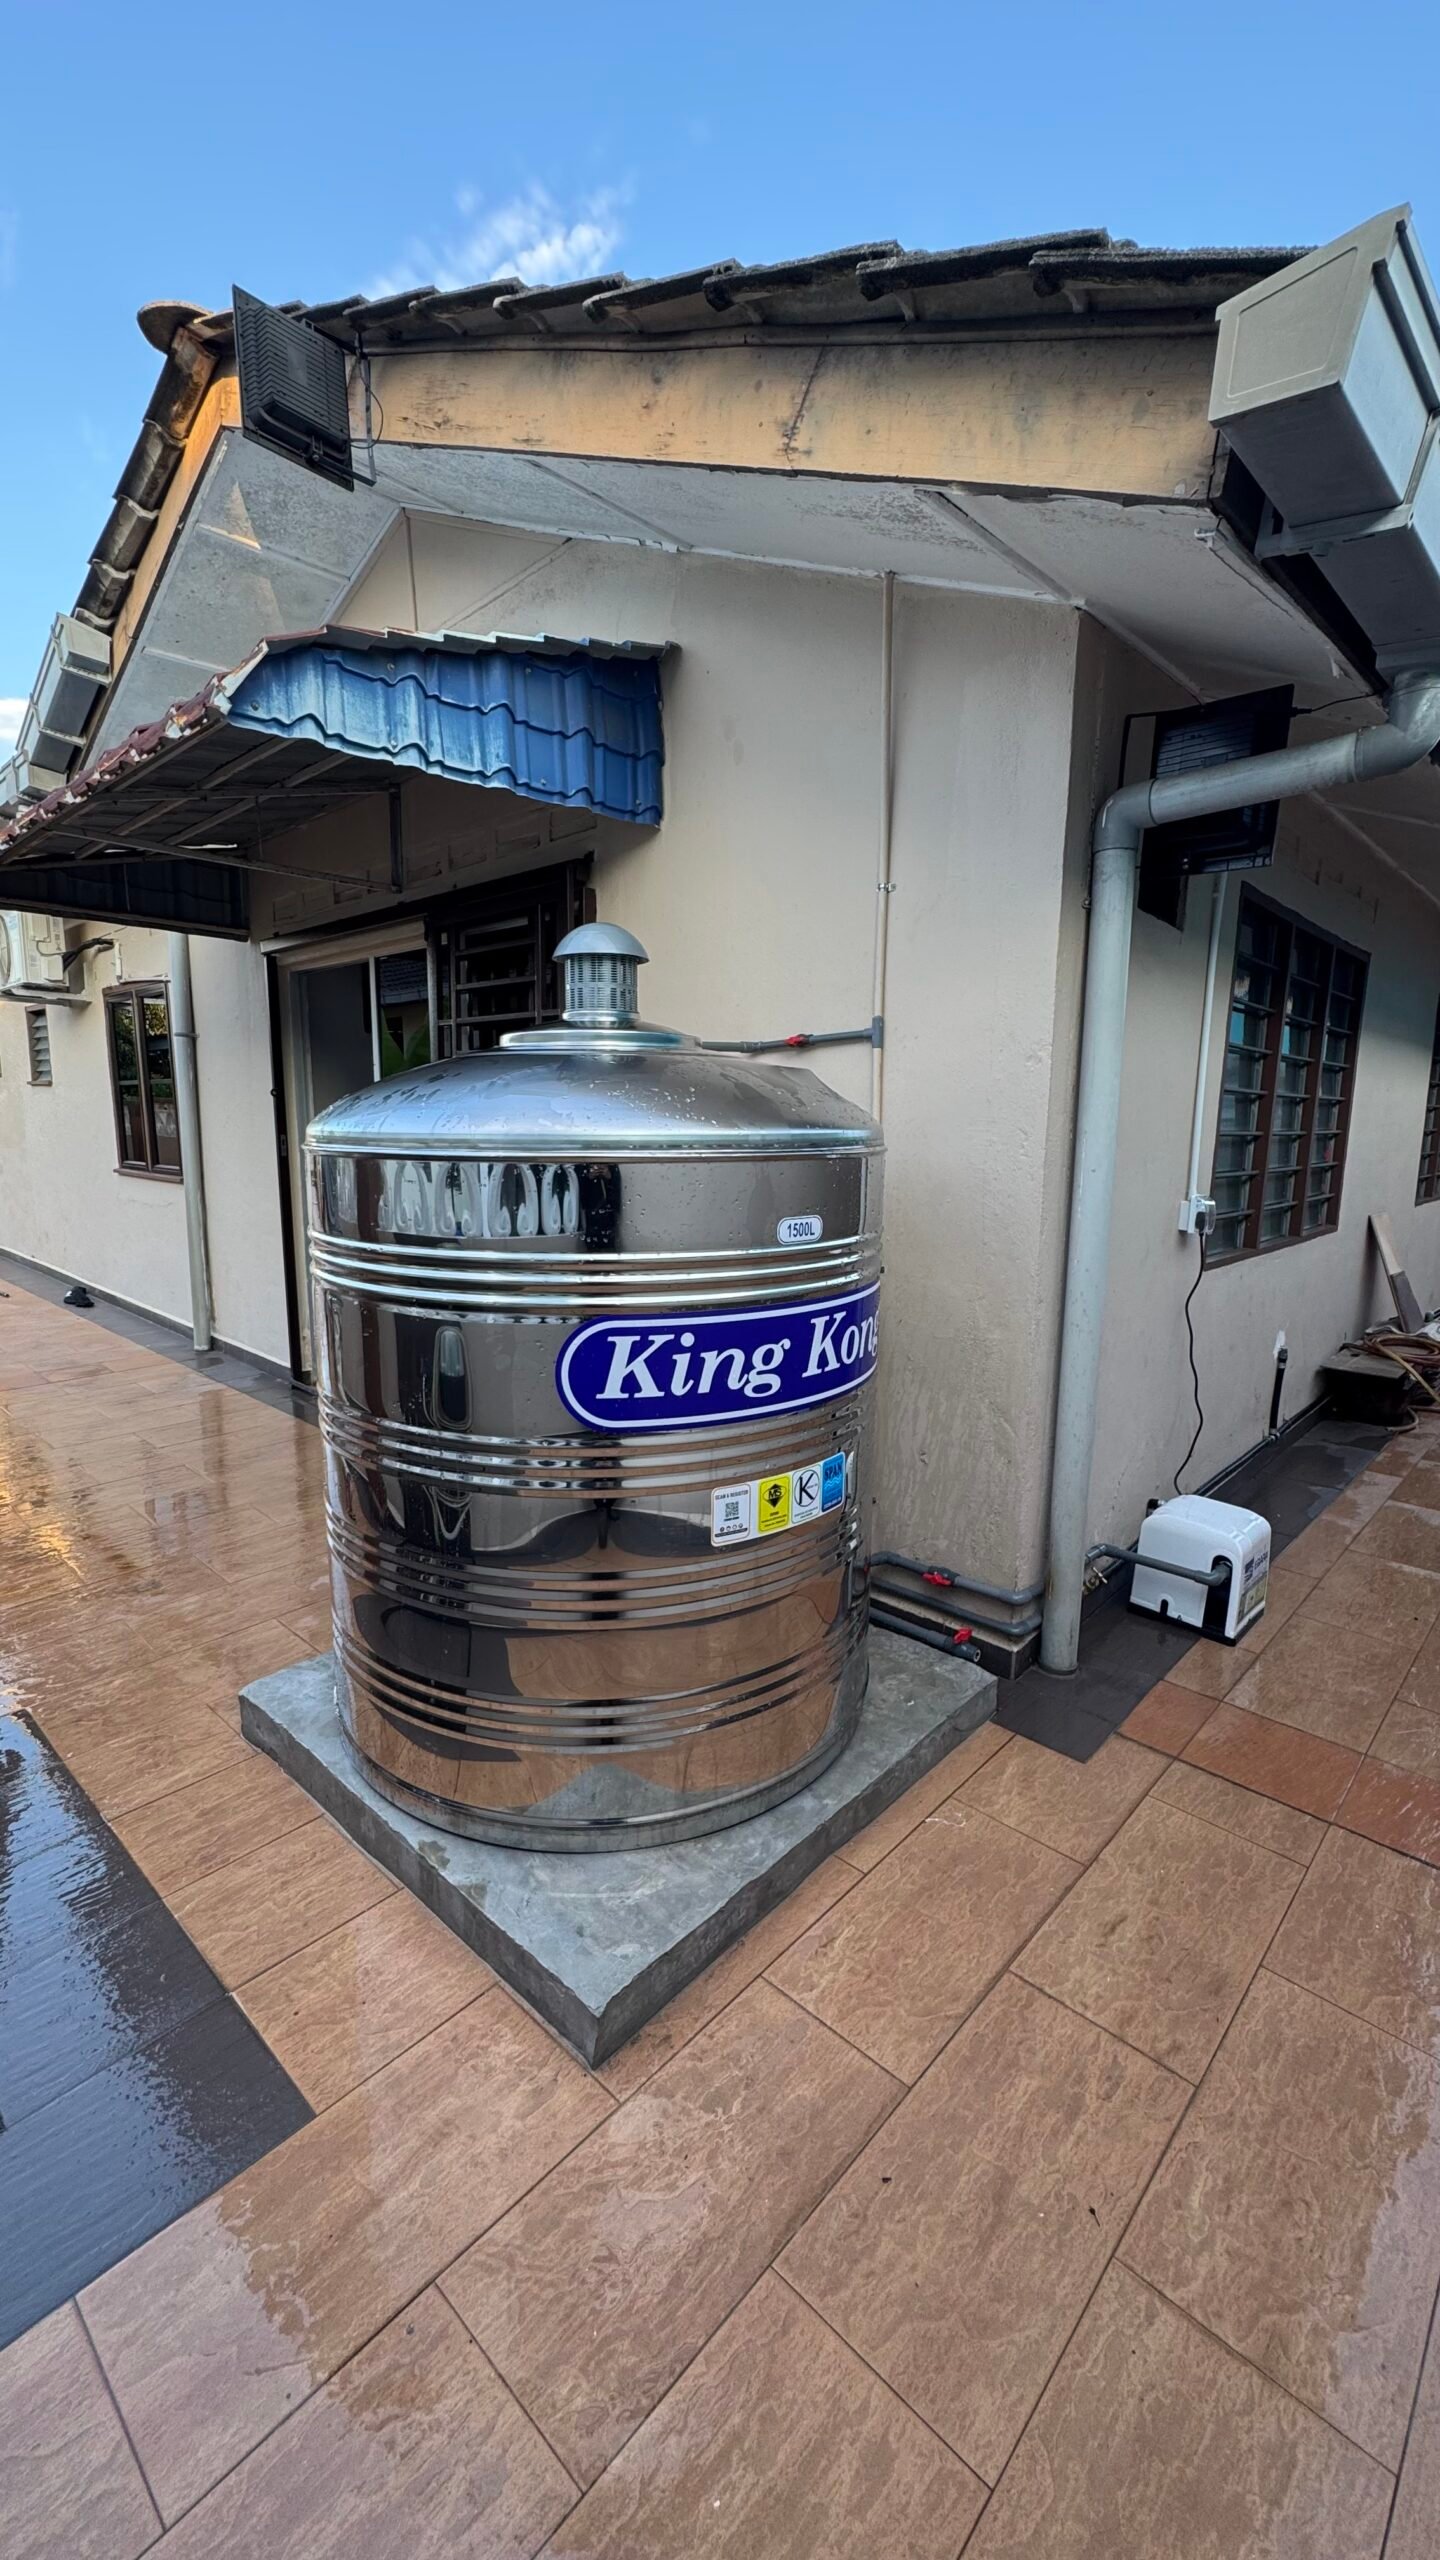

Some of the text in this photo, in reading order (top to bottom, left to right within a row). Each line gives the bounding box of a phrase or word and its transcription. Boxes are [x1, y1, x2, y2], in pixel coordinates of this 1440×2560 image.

[787, 1221, 815, 1238] 1500L
[596, 1331, 791, 1398] King
[824, 1462, 842, 1482] SPAN
[769, 1487, 782, 1500] MS
[799, 1472, 815, 1506] K
